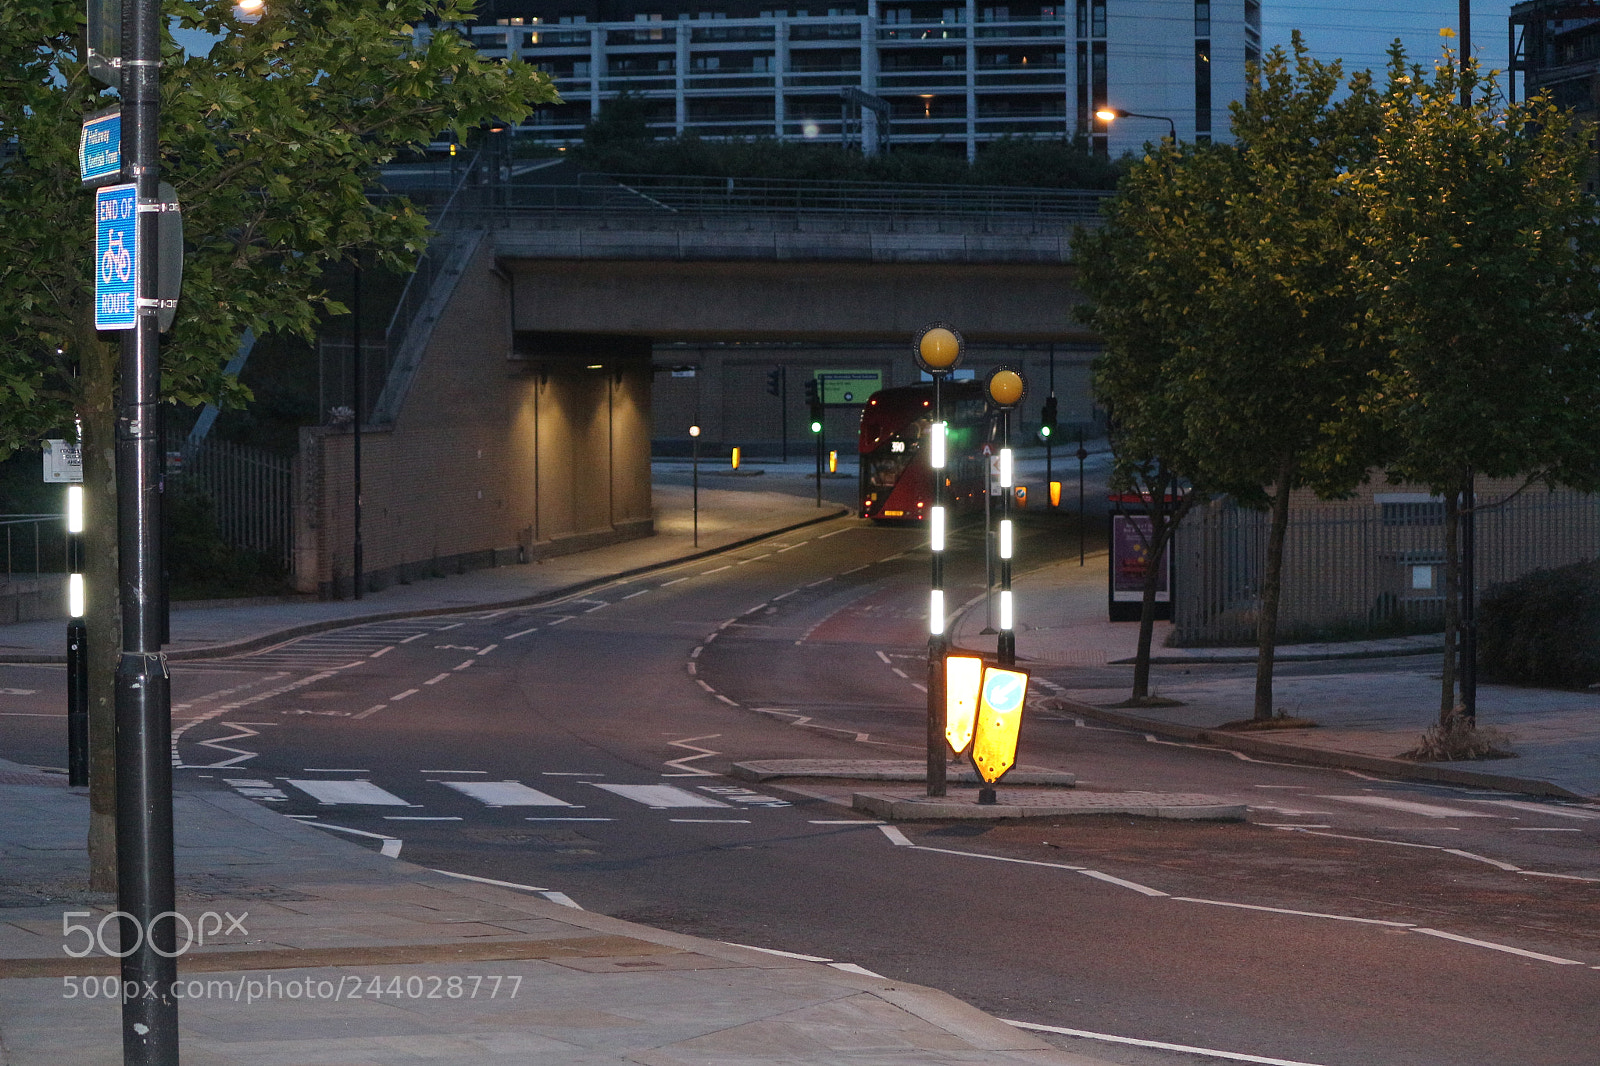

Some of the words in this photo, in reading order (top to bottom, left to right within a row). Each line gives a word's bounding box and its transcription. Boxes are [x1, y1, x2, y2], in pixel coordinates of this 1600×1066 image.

[88, 152, 105, 169] Kentish
[105, 149, 118, 165] Town
[100, 199, 118, 221] END
[121, 197, 133, 219] OF
[102, 293, 130, 314] ROUTE
[891, 441, 905, 453] 390
